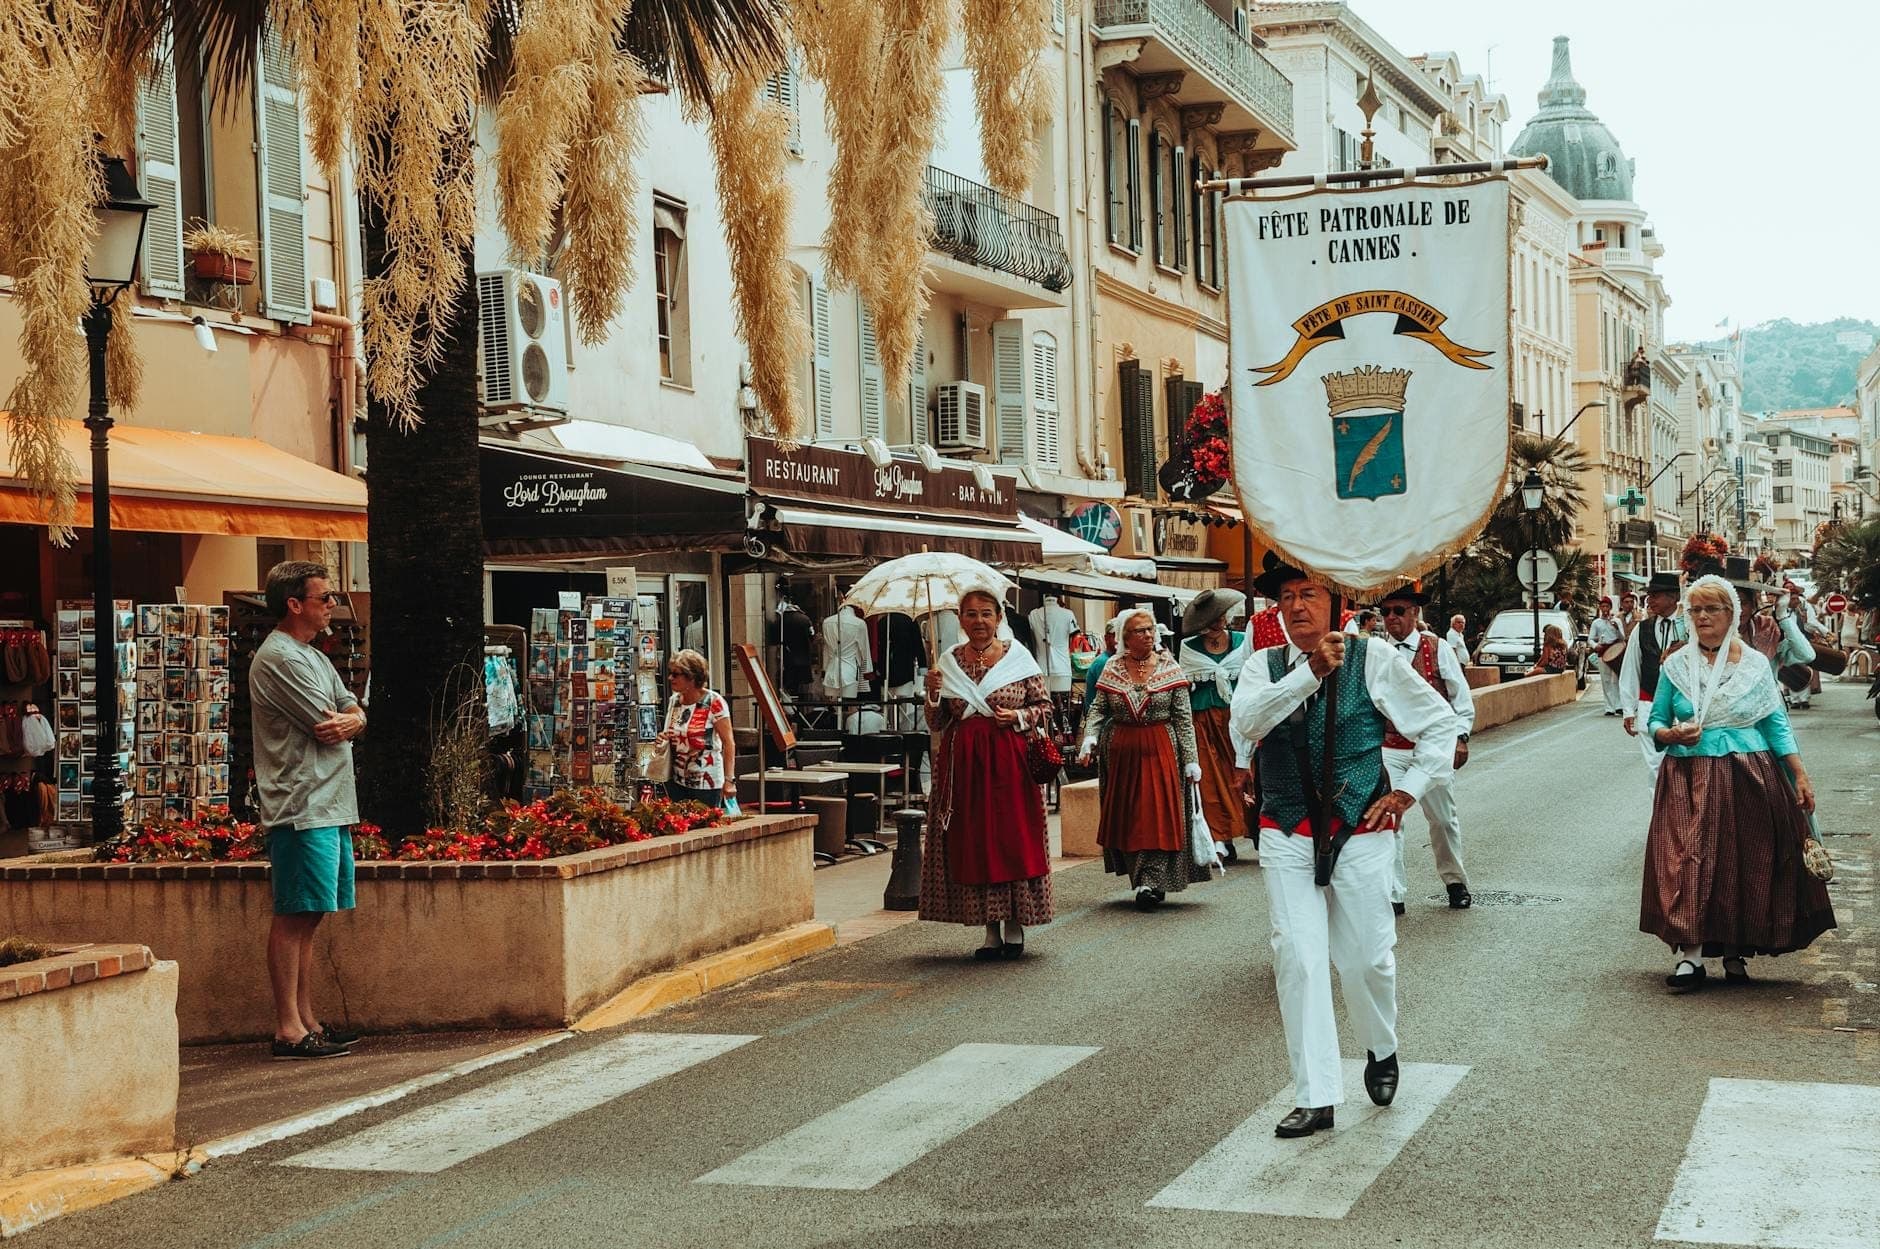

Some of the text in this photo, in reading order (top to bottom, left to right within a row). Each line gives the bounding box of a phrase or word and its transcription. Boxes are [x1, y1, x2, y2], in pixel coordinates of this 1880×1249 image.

[1258, 199, 1470, 240] FÊTE PATRONALE DE
[1328, 233, 1400, 264] CANNES
[1302, 295, 1439, 332] FÊTE DE SAINT CASSIEN
[550, 472, 594, 480] RESTAURANT
[766, 458, 840, 486] RESTAURANT
[959, 485, 975, 502] BAR
[504, 481, 608, 507] Lord Brougham
